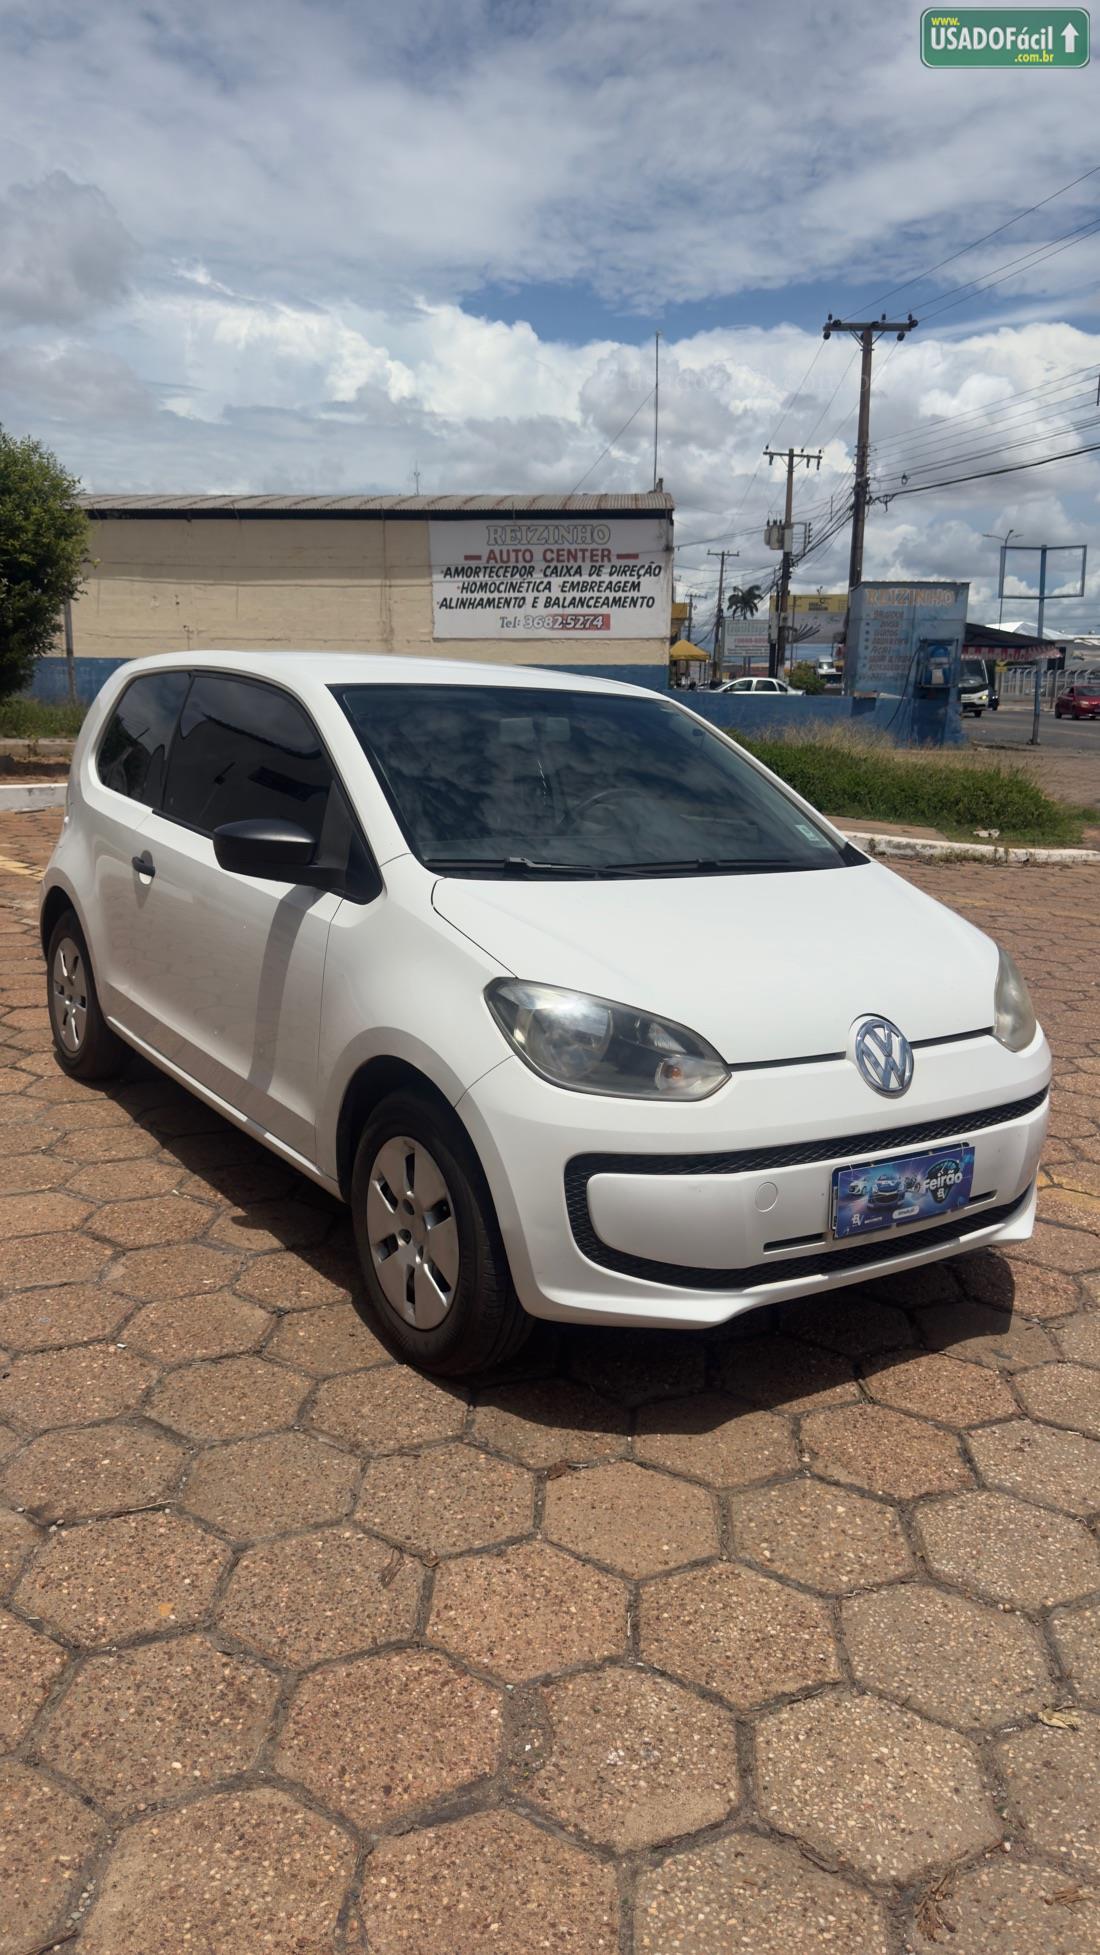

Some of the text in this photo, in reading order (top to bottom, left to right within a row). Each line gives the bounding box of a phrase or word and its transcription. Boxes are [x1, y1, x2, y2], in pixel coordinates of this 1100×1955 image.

[486, 524, 611, 546] REIZINHO
[486, 548, 612, 565] AUTO CENTER
[442, 561, 662, 580] AMORTECEDOR CAIXA DE DIREÇÃO
[459, 578, 641, 594] HOMOCINÉTICA EMBREAGEM
[438, 595, 656, 610] ALINHAMENTO E BALANCEAMENTO
[865, 588, 956, 608] REIZINHO
[499, 615, 521, 630] Tel:
[922, 1168, 963, 1193] Feirão
